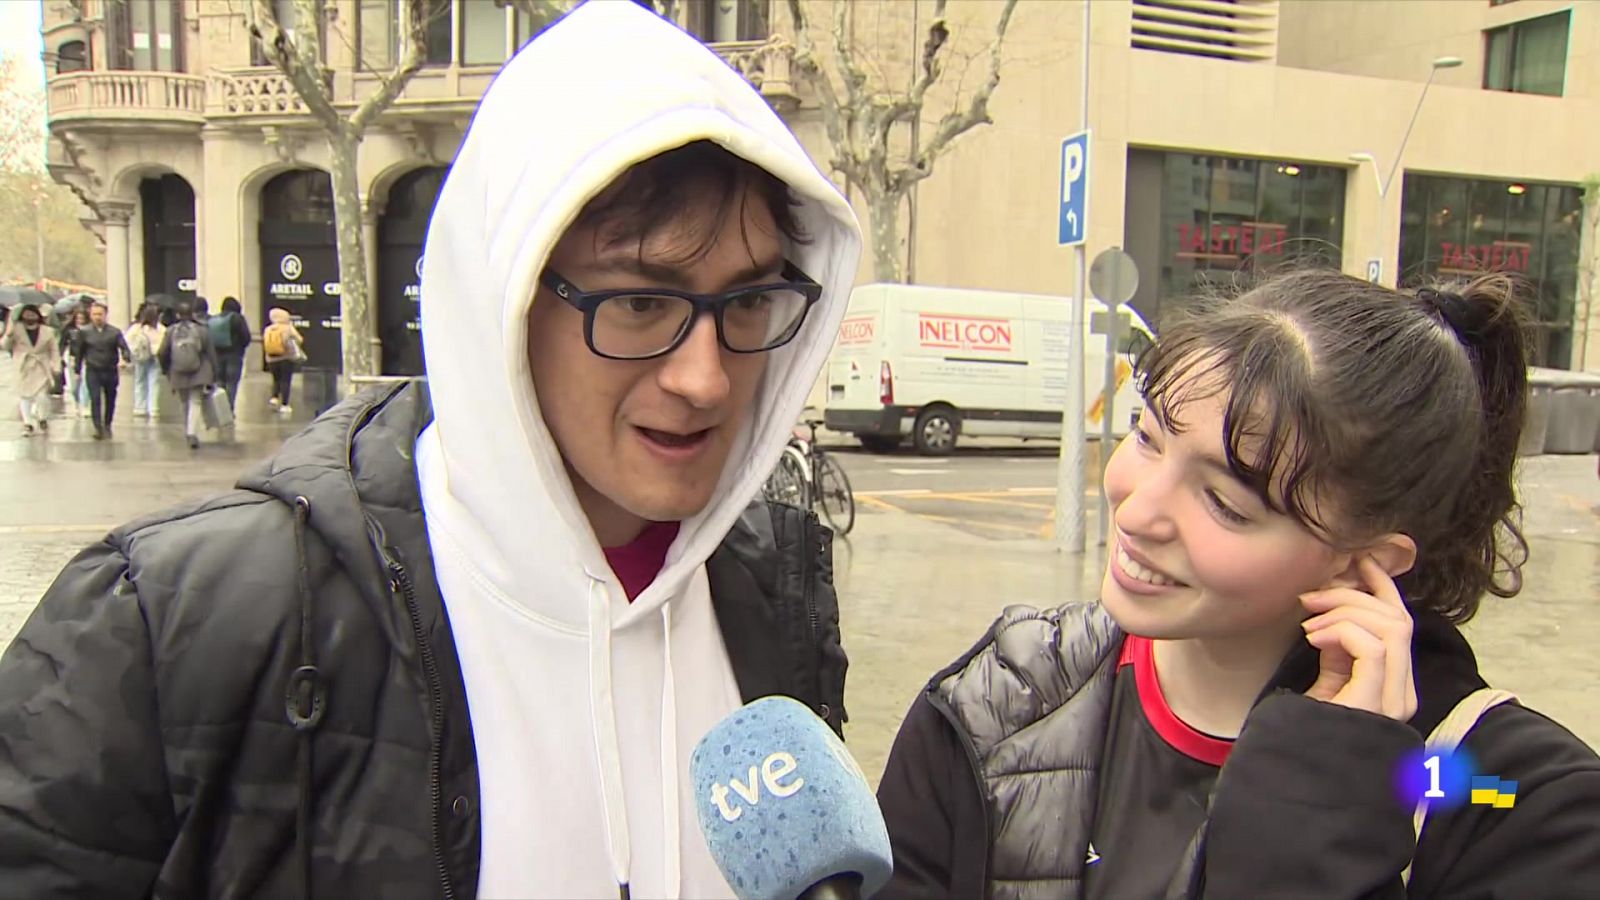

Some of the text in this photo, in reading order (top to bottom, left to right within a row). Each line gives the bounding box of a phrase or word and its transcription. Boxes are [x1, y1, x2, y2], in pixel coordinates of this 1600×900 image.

[1063, 142, 1083, 203] P
[1177, 223, 1287, 255] TASTEAT
[1440, 242, 1530, 271] TASTEAT
[178, 279, 196, 291] CB
[270, 283, 314, 295] ARETAIL
[324, 282, 341, 295] CB
[404, 285, 420, 296] AR
[919, 320, 1011, 344] INELCON
[710, 751, 804, 822] tve
